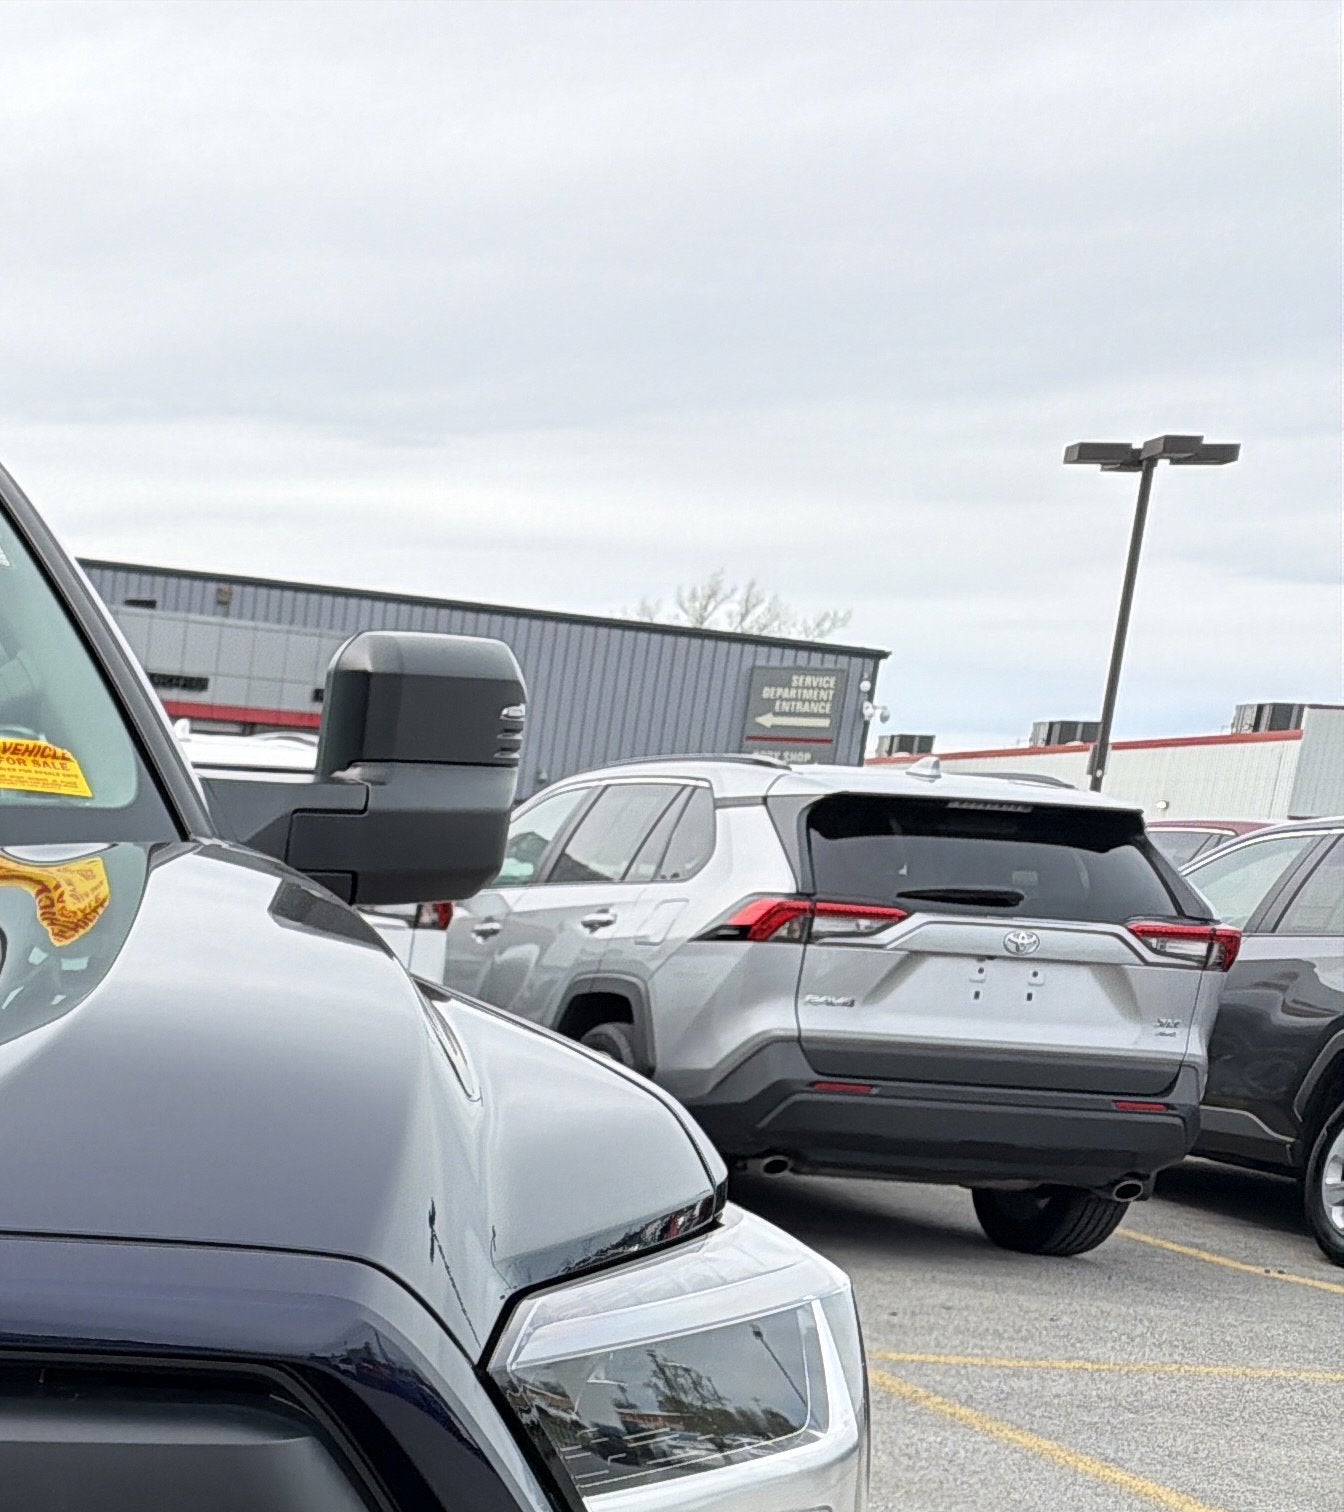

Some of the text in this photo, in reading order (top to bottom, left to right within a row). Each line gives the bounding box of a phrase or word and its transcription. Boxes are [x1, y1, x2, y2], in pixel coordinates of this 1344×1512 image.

[791, 674, 837, 688] SERVICE
[762, 686, 834, 701] DEPARTMENT
[774, 701, 833, 714] ENTRANCE
[32, 758, 71, 771] SALE
